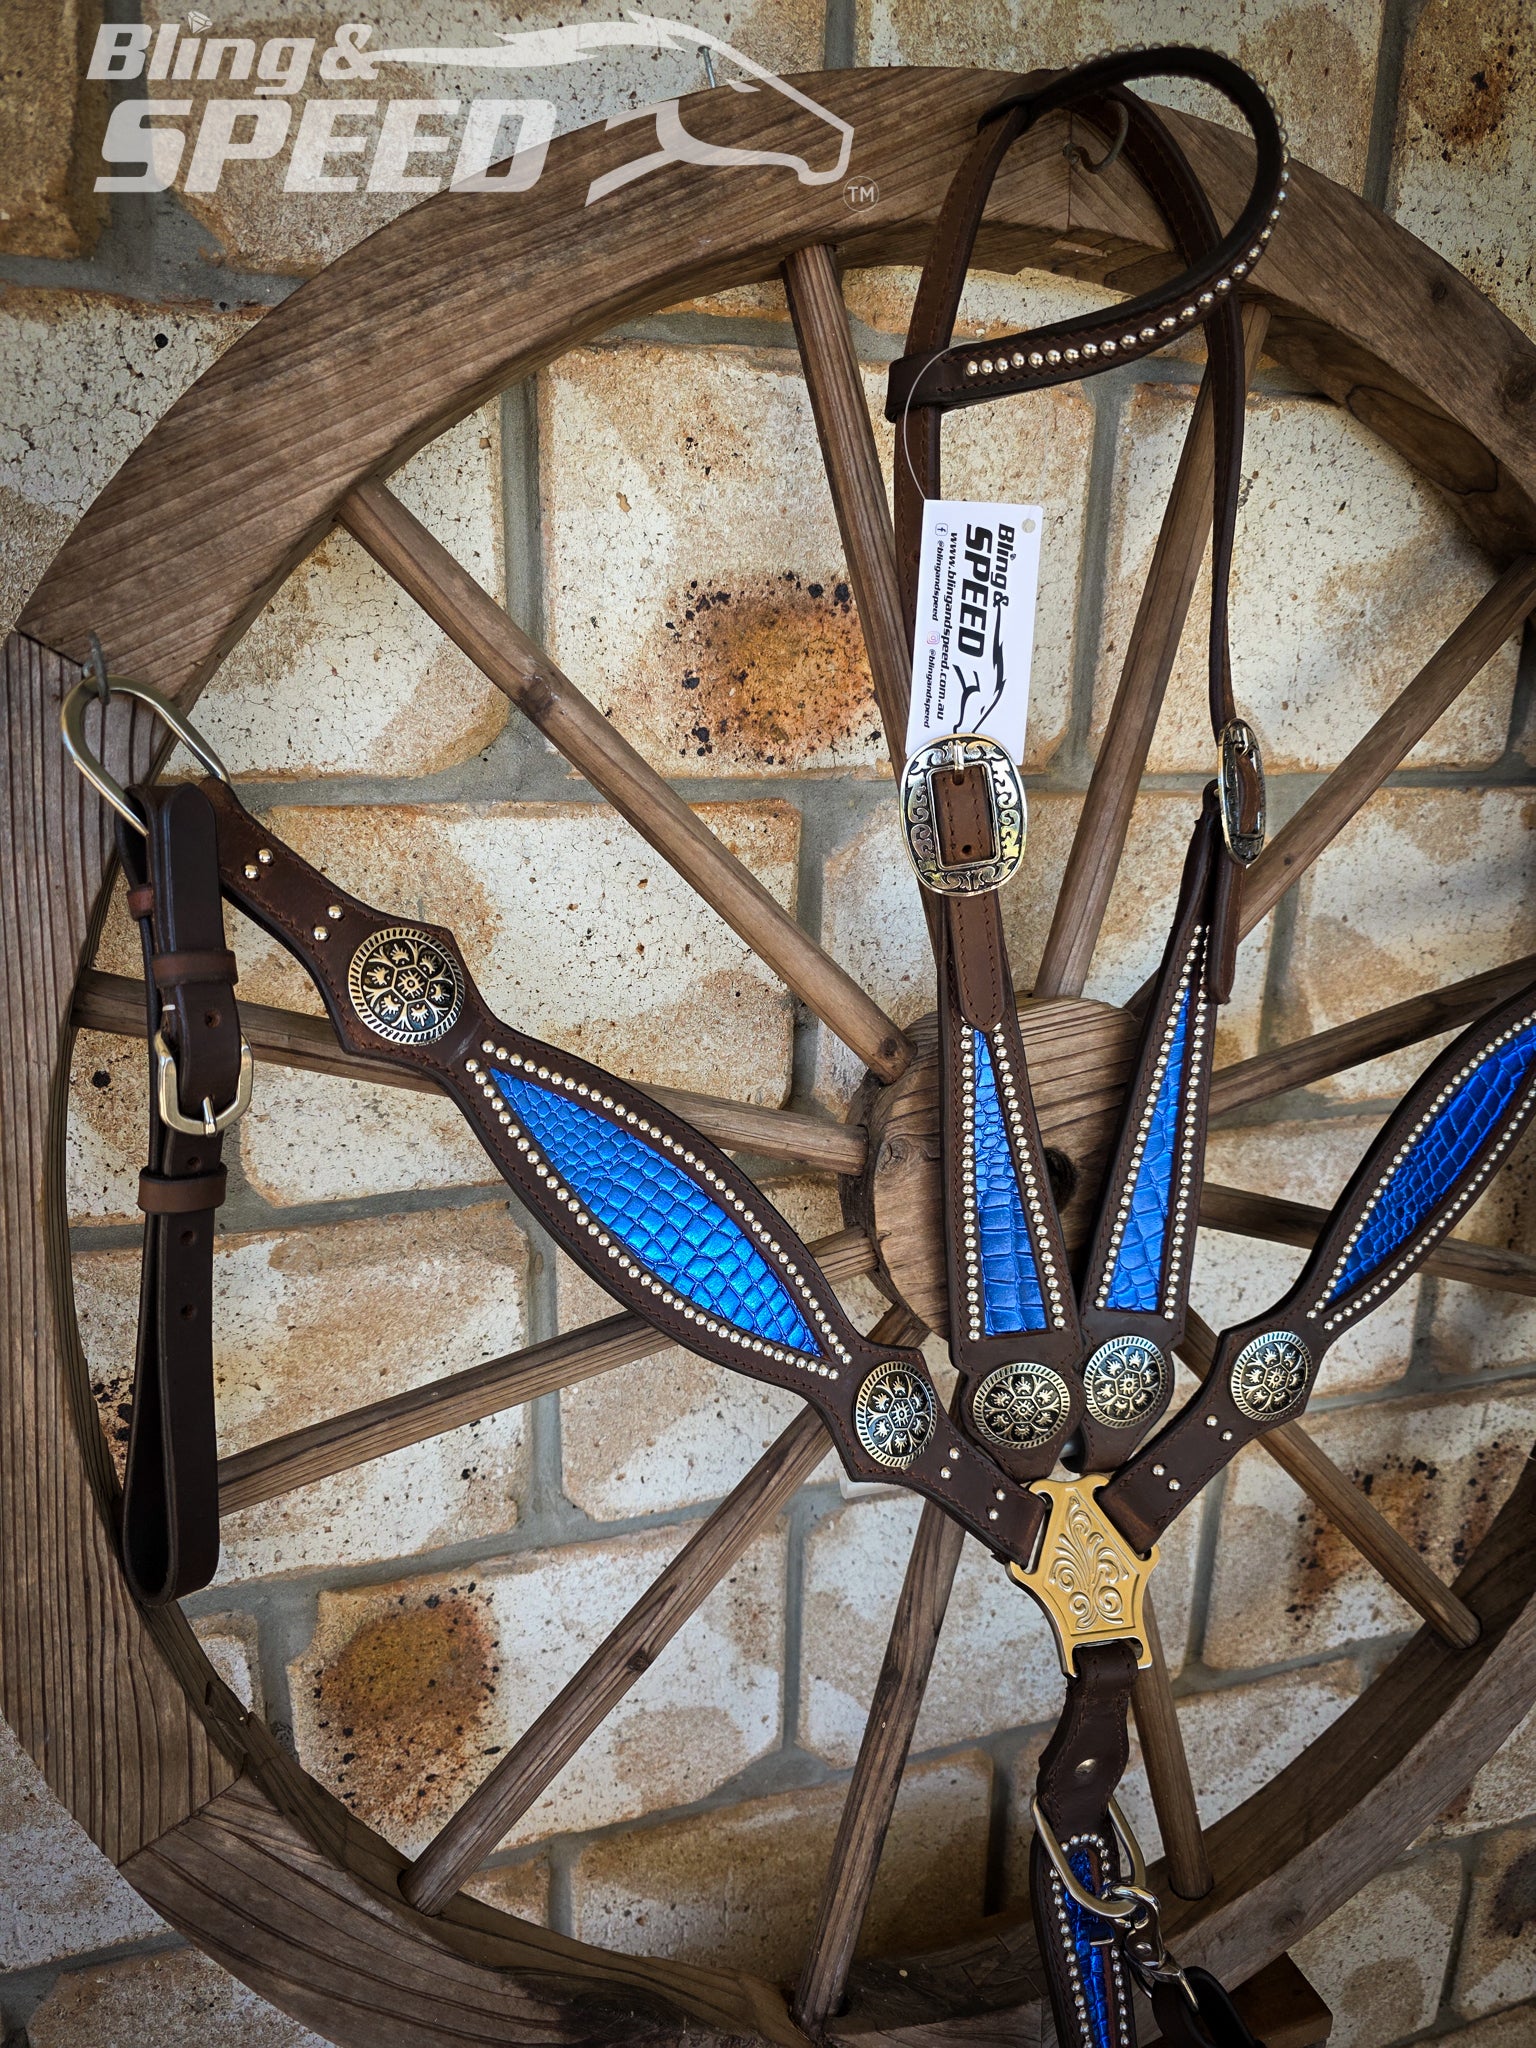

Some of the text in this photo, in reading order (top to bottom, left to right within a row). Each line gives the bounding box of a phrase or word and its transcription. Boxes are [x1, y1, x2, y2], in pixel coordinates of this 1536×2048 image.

[931, 540, 945, 622] @blingandspeed
[936, 532, 958, 720] www.blingandspeed.com.au
[957, 523, 993, 658] SPEED
[923, 648, 937, 728] @blingandspeed
